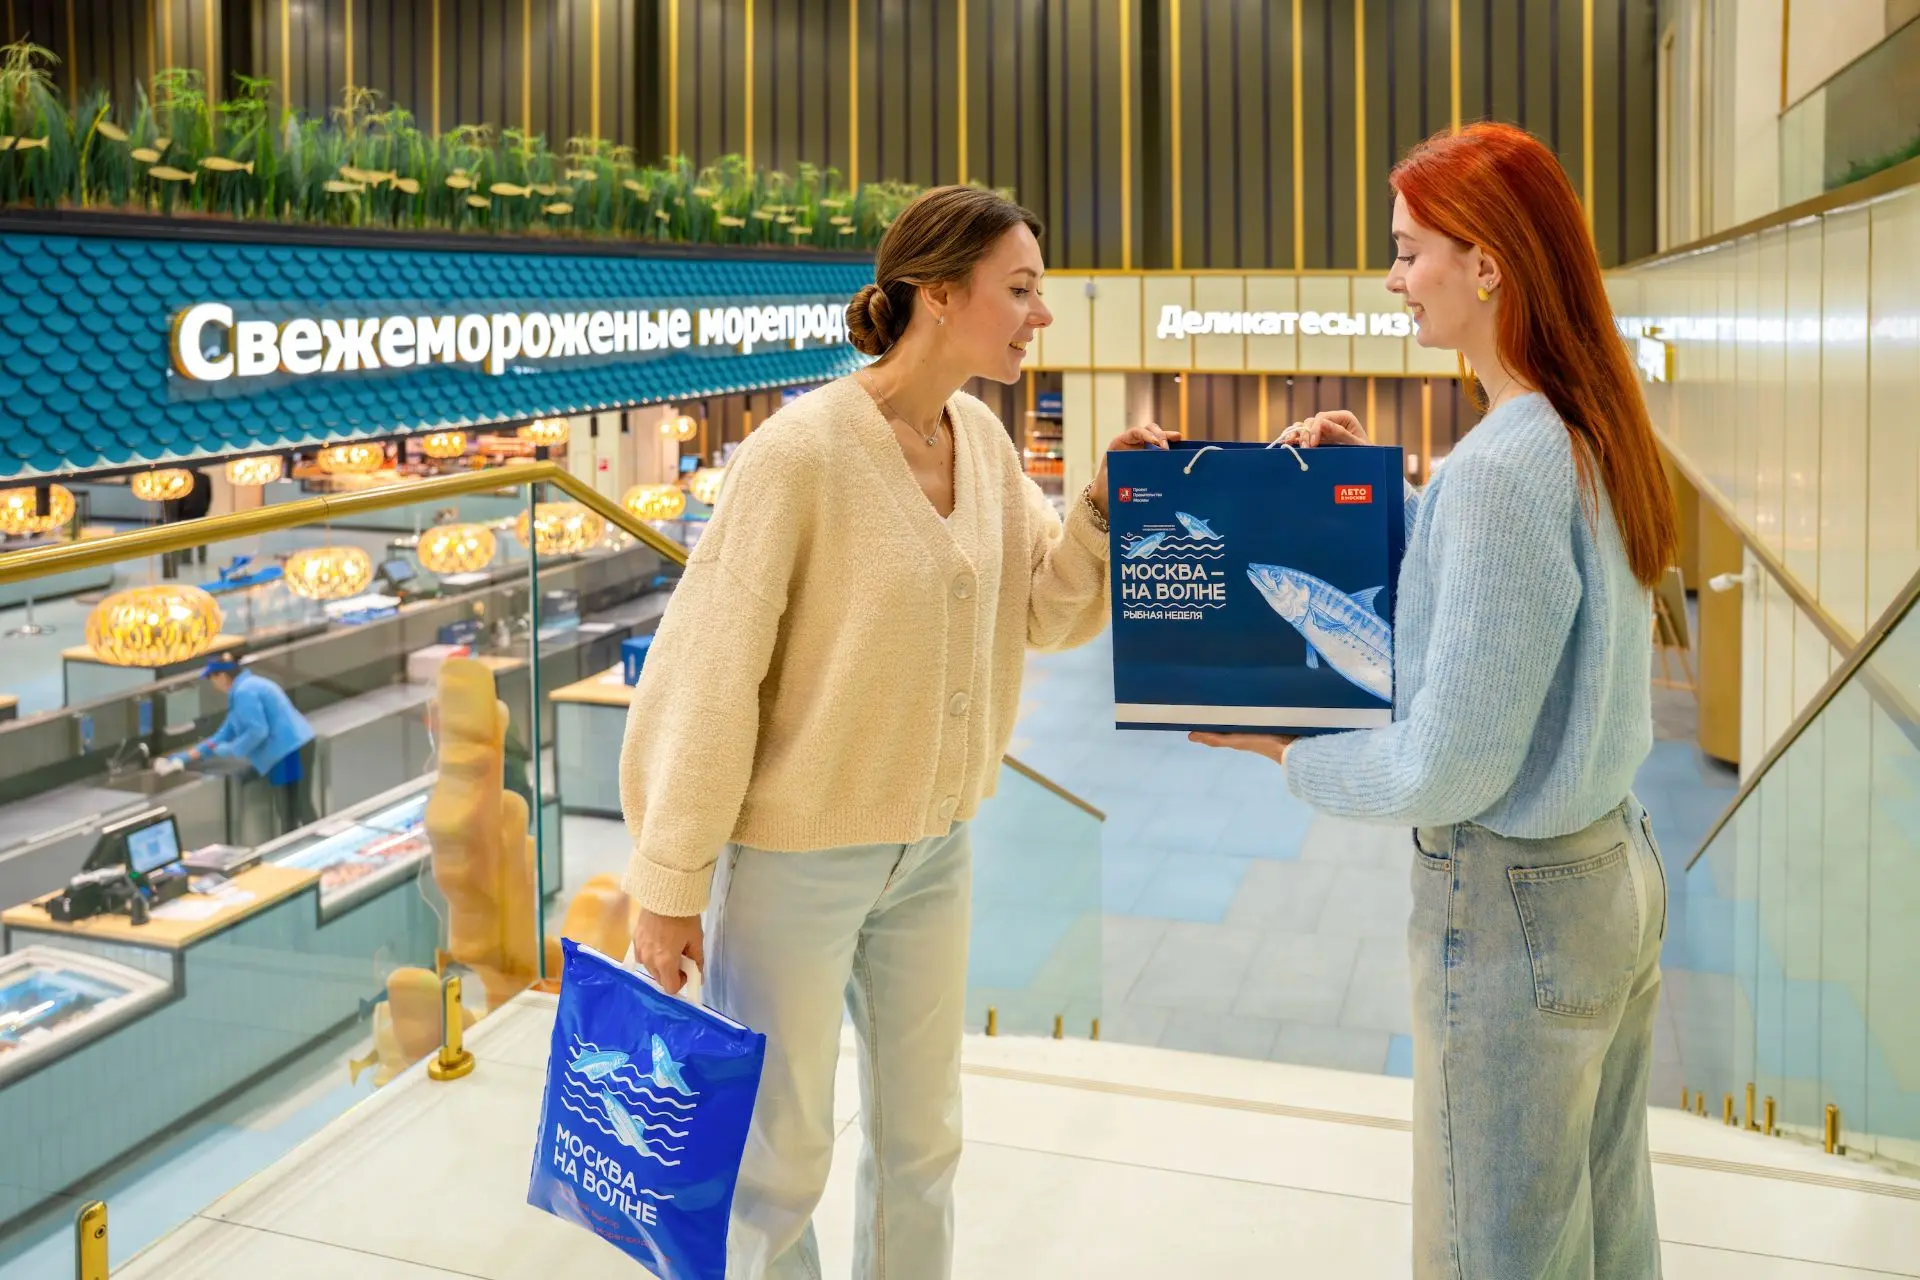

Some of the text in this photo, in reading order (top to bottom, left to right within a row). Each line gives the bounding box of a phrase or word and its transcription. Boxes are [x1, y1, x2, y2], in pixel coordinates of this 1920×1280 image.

[1157, 305, 1365, 339] Деликатесы
[1369, 312, 1410, 336] из
[171, 303, 691, 381] Свежемороженые
[1340, 488, 1367, 496] ЛЕТО
[1121, 563, 1208, 581] МОСКВА
[1122, 582, 1226, 601] НА ВОЛНЕ
[1123, 610, 1203, 620] РЫБНАЯ НЕДЕЛЯ
[555, 1122, 638, 1196] МОСКВА
[553, 1146, 579, 1184] НА
[582, 1167, 657, 1227] ВОЛНЕ
